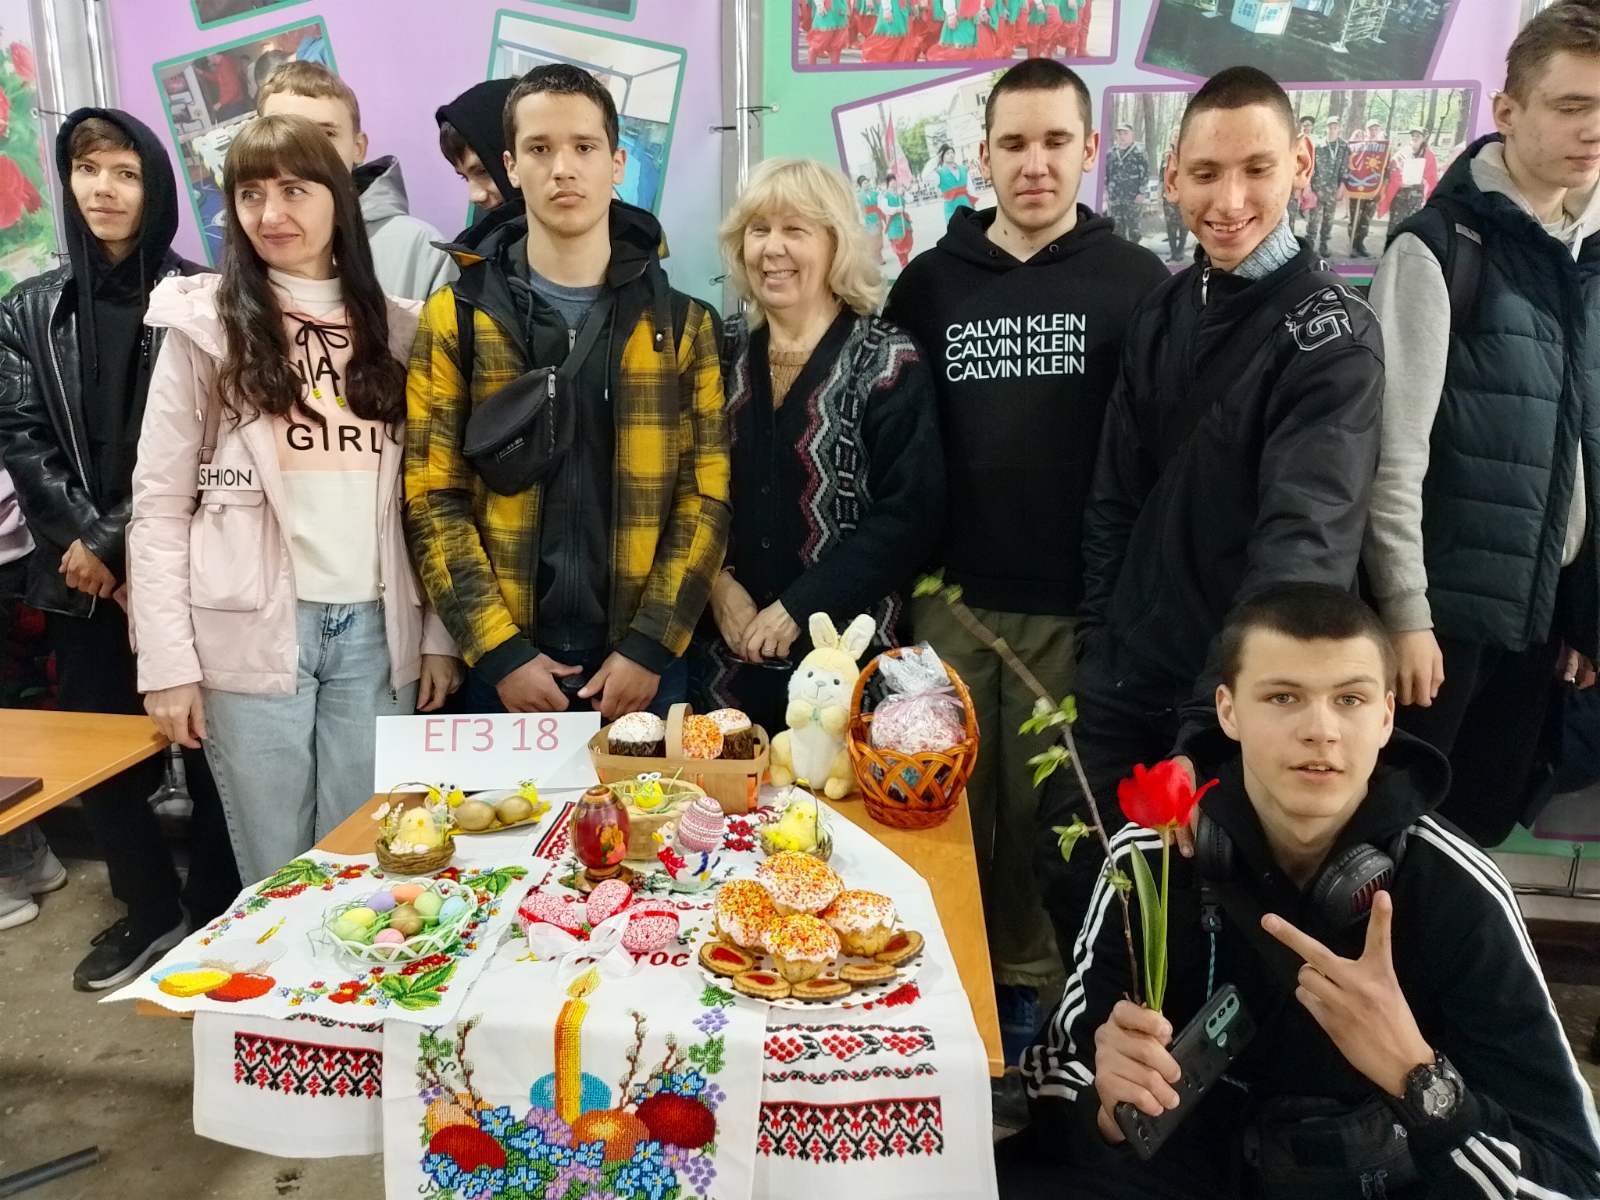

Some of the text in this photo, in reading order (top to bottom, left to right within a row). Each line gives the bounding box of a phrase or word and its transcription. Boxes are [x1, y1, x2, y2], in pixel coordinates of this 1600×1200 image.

[946, 313, 1086, 342] CALVIN KLEIN
[945, 334, 1085, 361] CALVIN KLEIN
[946, 355, 1085, 382] CALVIN KLEIN
[286, 423, 382, 454] GIRL
[198, 468, 251, 486] SHION
[512, 717, 559, 751] 18
